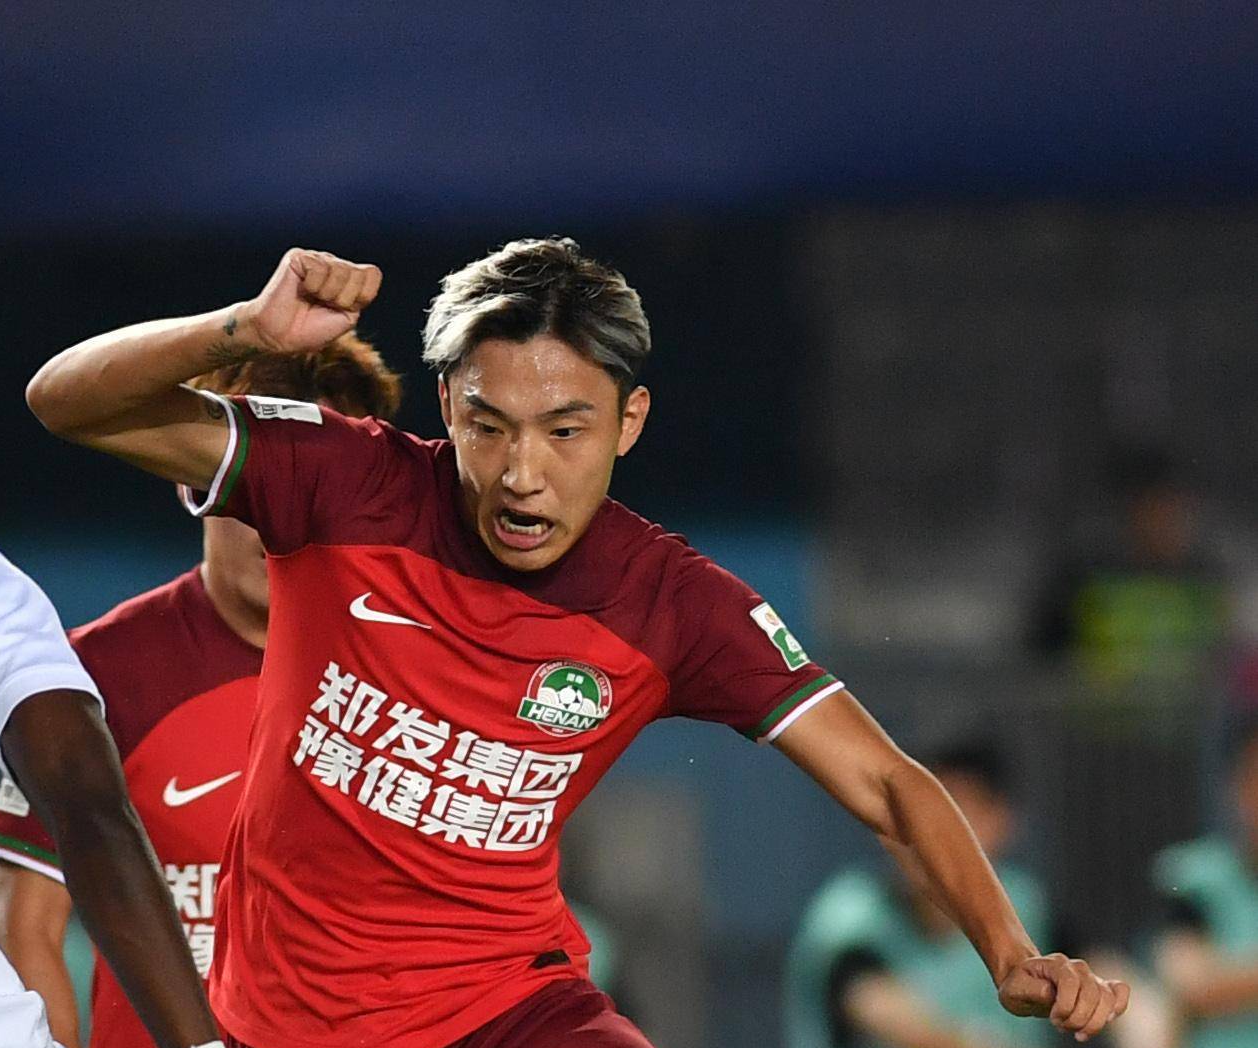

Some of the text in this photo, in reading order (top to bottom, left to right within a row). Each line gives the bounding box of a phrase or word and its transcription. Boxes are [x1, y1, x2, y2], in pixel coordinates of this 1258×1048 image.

[292, 714, 557, 852] 豫健集团
[309, 660, 584, 800] 郑发集团
[526, 703, 596, 730] HENAN
